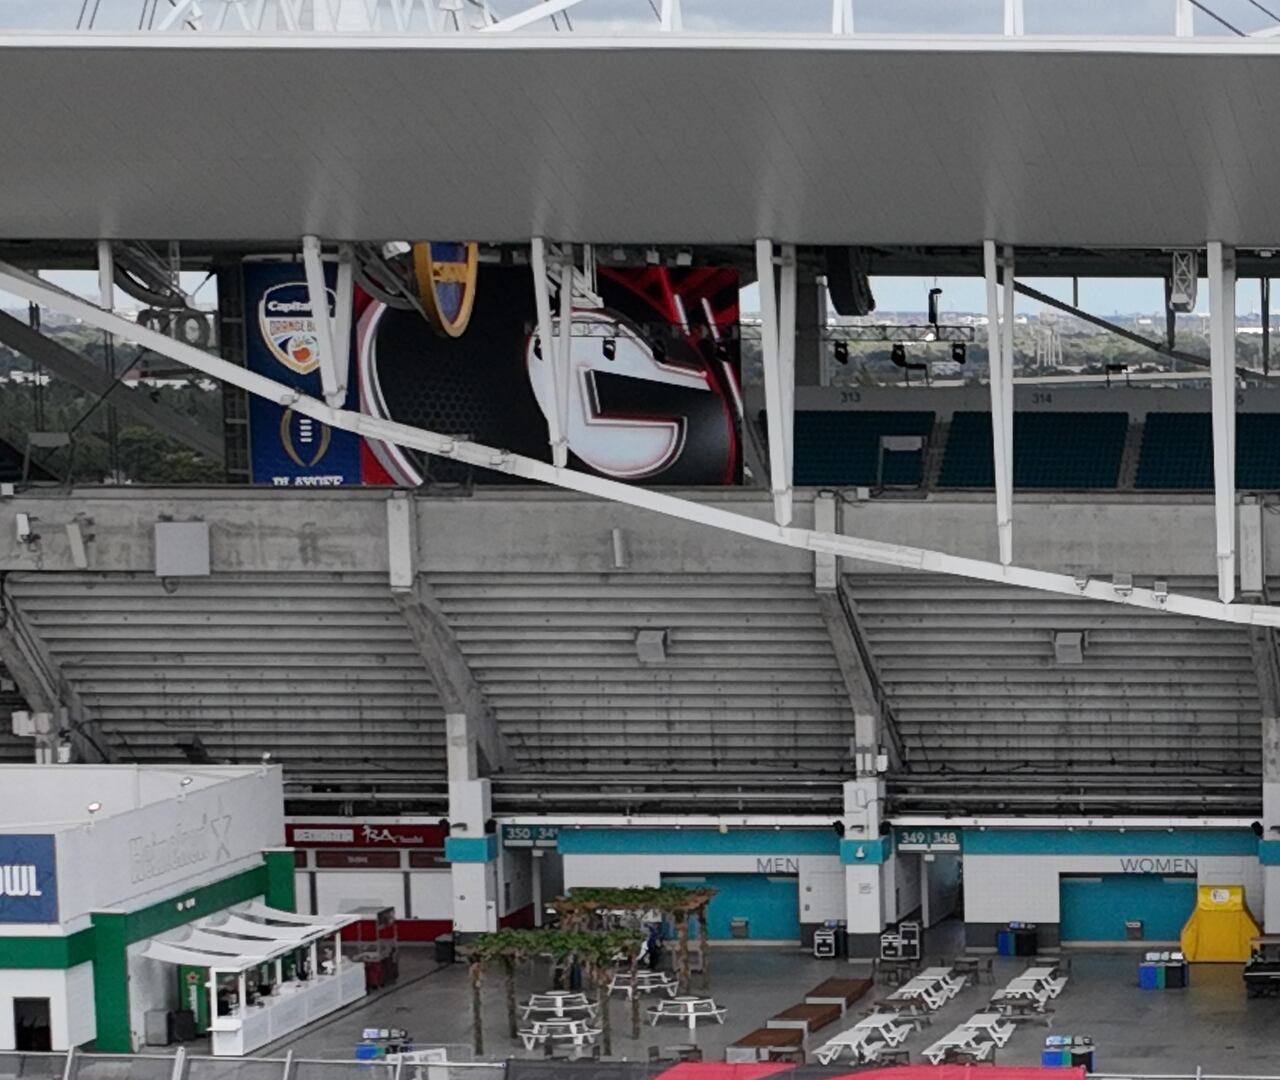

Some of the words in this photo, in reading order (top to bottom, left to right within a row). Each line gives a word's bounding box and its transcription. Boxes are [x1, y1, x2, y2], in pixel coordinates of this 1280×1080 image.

[507, 827, 531, 840] 350
[901, 832, 926, 843] 349
[932, 832, 958, 843] 348
[756, 857, 800, 873] MEN
[1119, 858, 1198, 872] WOMEN
[0, 865, 42, 896] WL
